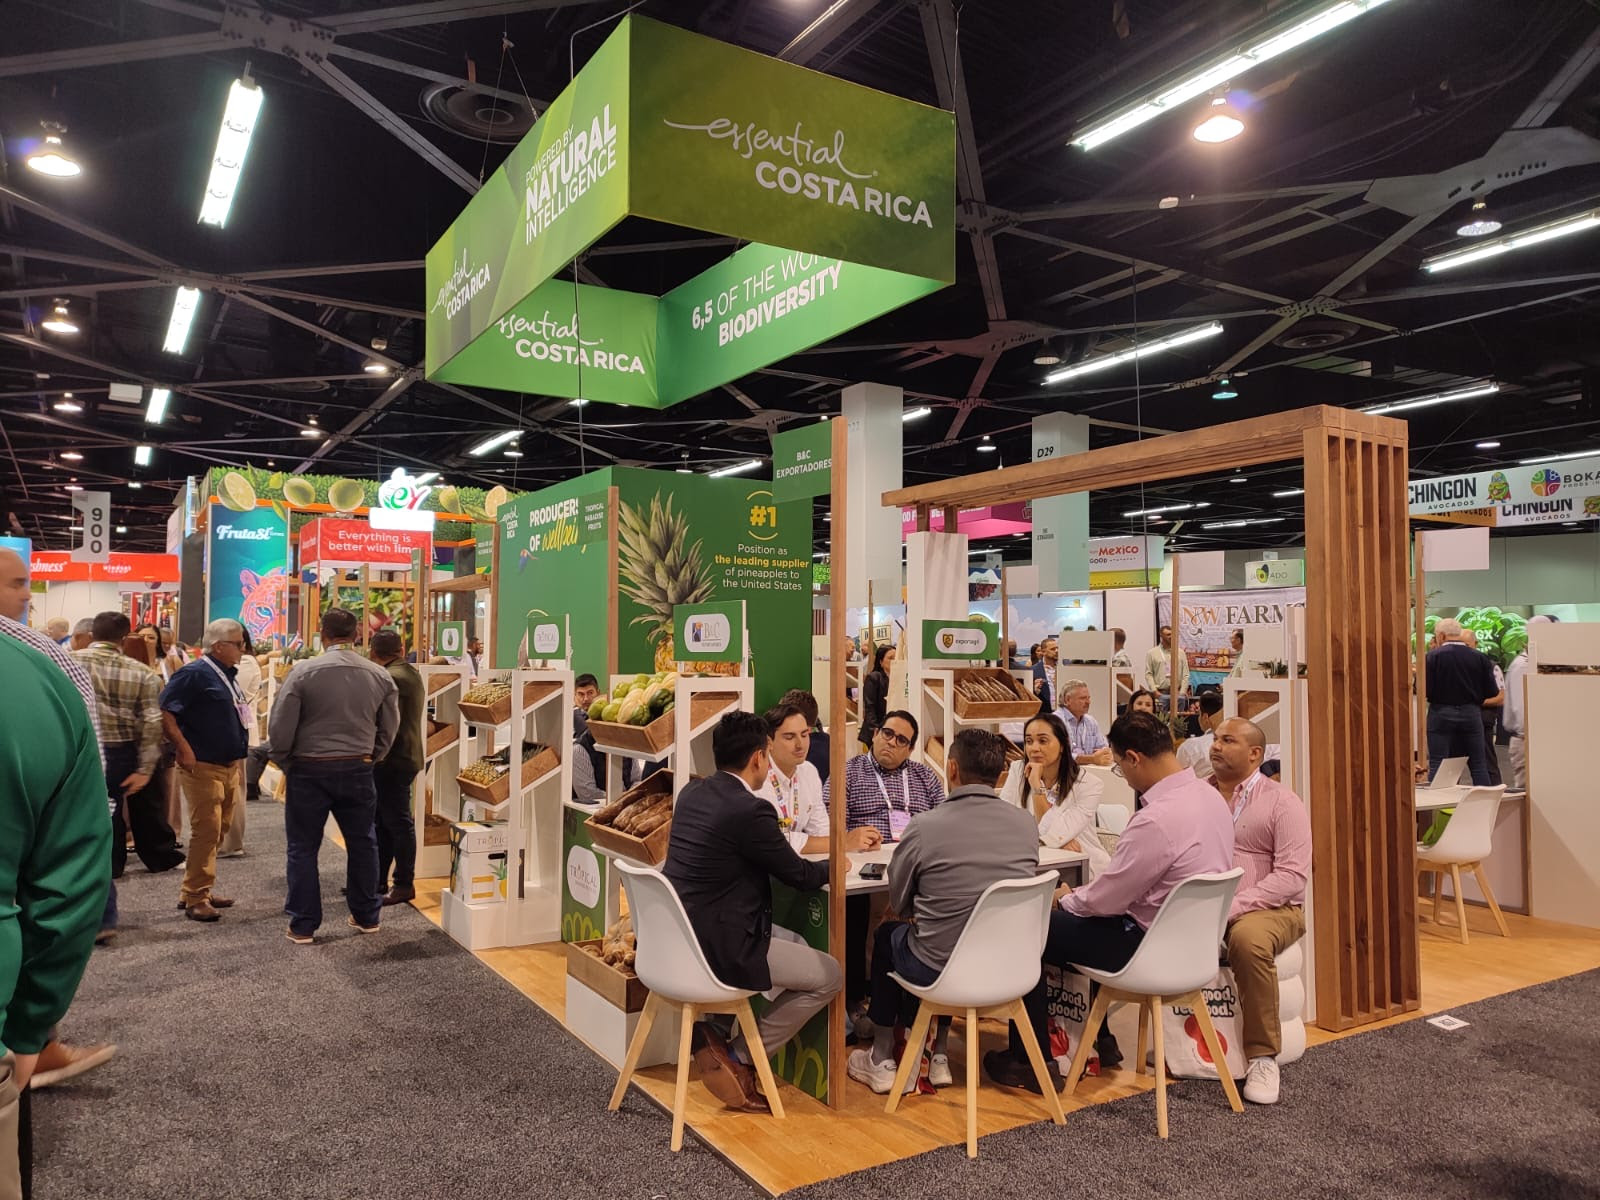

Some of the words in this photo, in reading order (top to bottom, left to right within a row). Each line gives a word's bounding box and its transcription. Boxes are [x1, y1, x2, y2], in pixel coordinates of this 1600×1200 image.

[526, 141, 561, 186] POWERED
[563, 124, 574, 147] BY
[664, 118, 878, 179] essential
[526, 103, 617, 221] NATURAL
[526, 138, 617, 246] INTELLIGENCE
[755, 161, 859, 210] COSTA
[864, 186, 934, 229] RICA
[446, 279, 471, 321] COSTA
[471, 263, 491, 297] RICA
[692, 300, 713, 332] 6,5
[716, 286, 739, 316] OF
[744, 264, 776, 302] THE
[718, 259, 843, 347] BIODIVERSITY
[515, 338, 588, 369] COSTA
[593, 346, 646, 375] RICA
[796, 450, 812, 462] B&C
[1037, 446, 1054, 459] D29
[776, 458, 832, 479] EXPORTADORES
[1428, 500, 1475, 510] AVOCADOS
[750, 505, 777, 527] #1
[1524, 513, 1571, 522] AVOCADOS
[328, 541, 364, 552] better
[366, 542, 391, 553] with
[338, 530, 399, 545] Everything
[403, 534, 412, 543] is
[530, 534, 541, 552] OF
[738, 543, 776, 555] Position
[778, 547, 788, 555] as
[1099, 545, 1139, 556] Mexico
[715, 555, 731, 564] the
[734, 555, 769, 568] leading
[772, 557, 810, 569] supplier
[725, 567, 735, 576] of
[738, 568, 788, 580] pineapples
[790, 570, 800, 579] to
[722, 579, 739, 588] the
[740, 580, 771, 590] United
[774, 581, 802, 591] States
[570, 864, 598, 888] TROPICAL
